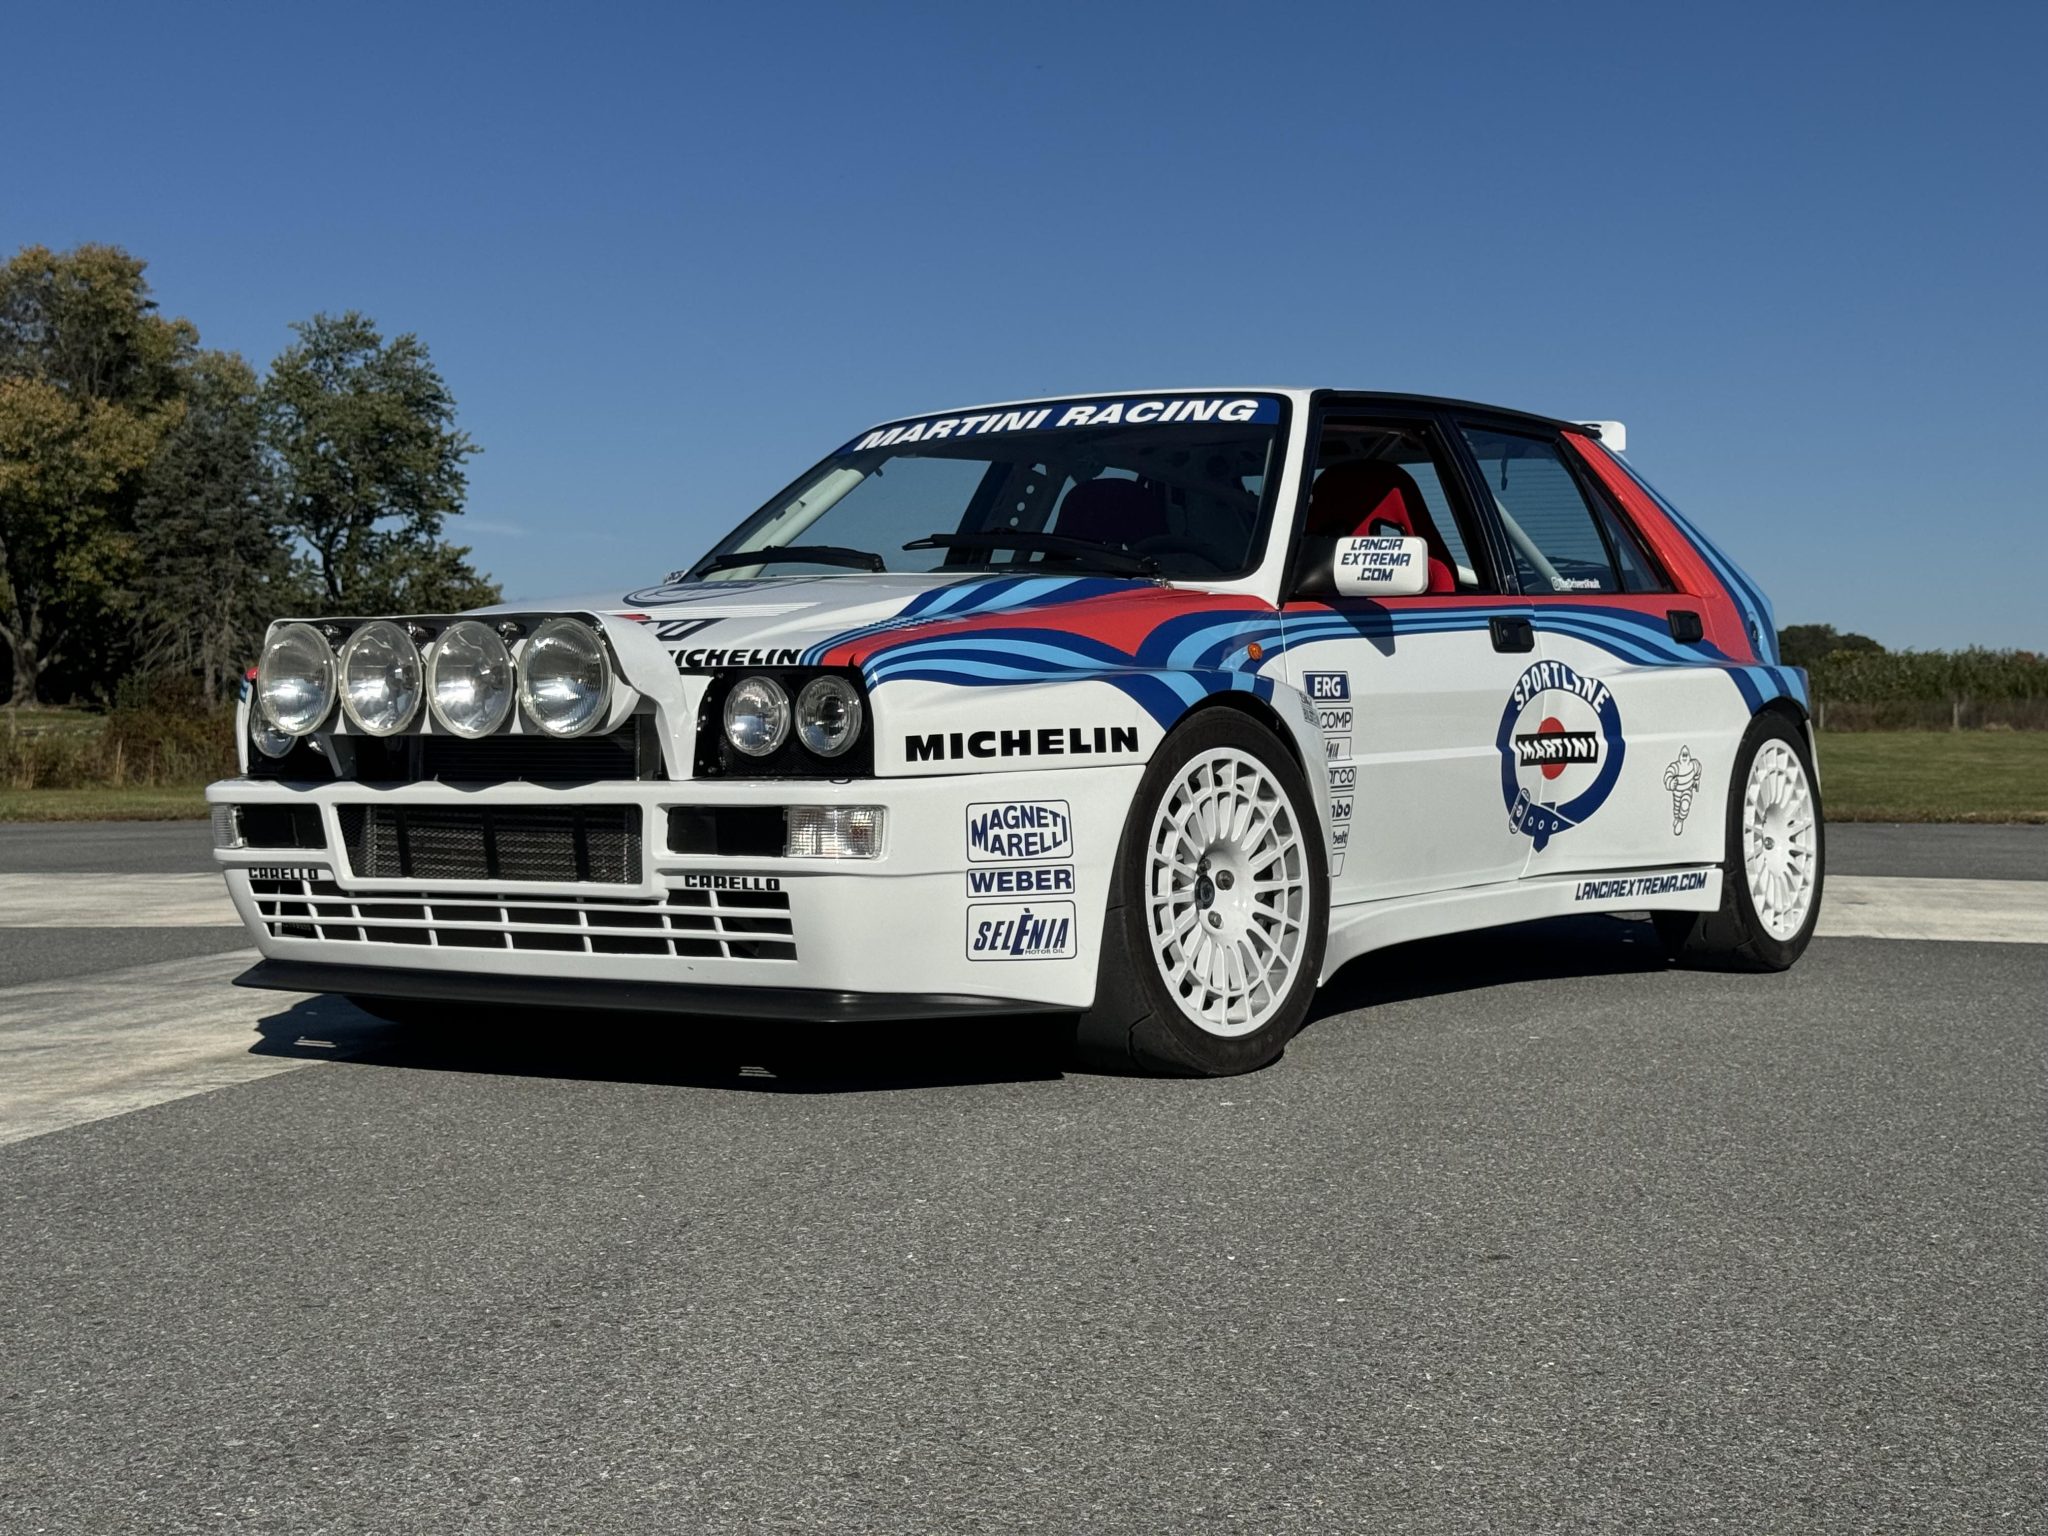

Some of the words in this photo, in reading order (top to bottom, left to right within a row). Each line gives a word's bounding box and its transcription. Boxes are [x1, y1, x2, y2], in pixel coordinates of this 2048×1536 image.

[853, 409, 1053, 452] MARTINI
[1056, 400, 1259, 427] RACING
[1350, 539, 1404, 551] LANCIA
[1341, 553, 1411, 566] EXTREMA
[1357, 568, 1394, 581] .COM
[1314, 676, 1342, 697] ERG
[1514, 662, 1610, 713] SPORTLINE
[905, 727, 1139, 762] MICHELIN
[1517, 737, 1598, 760] MARTINI
[971, 805, 1068, 838] MAGNETI
[971, 824, 1068, 856] MARELLI
[248, 867, 318, 880] CARELLO
[685, 875, 780, 891] CARELLO
[970, 869, 1072, 892] WEBER
[1575, 872, 1707, 900] LANCIAEXTREMA.COM
